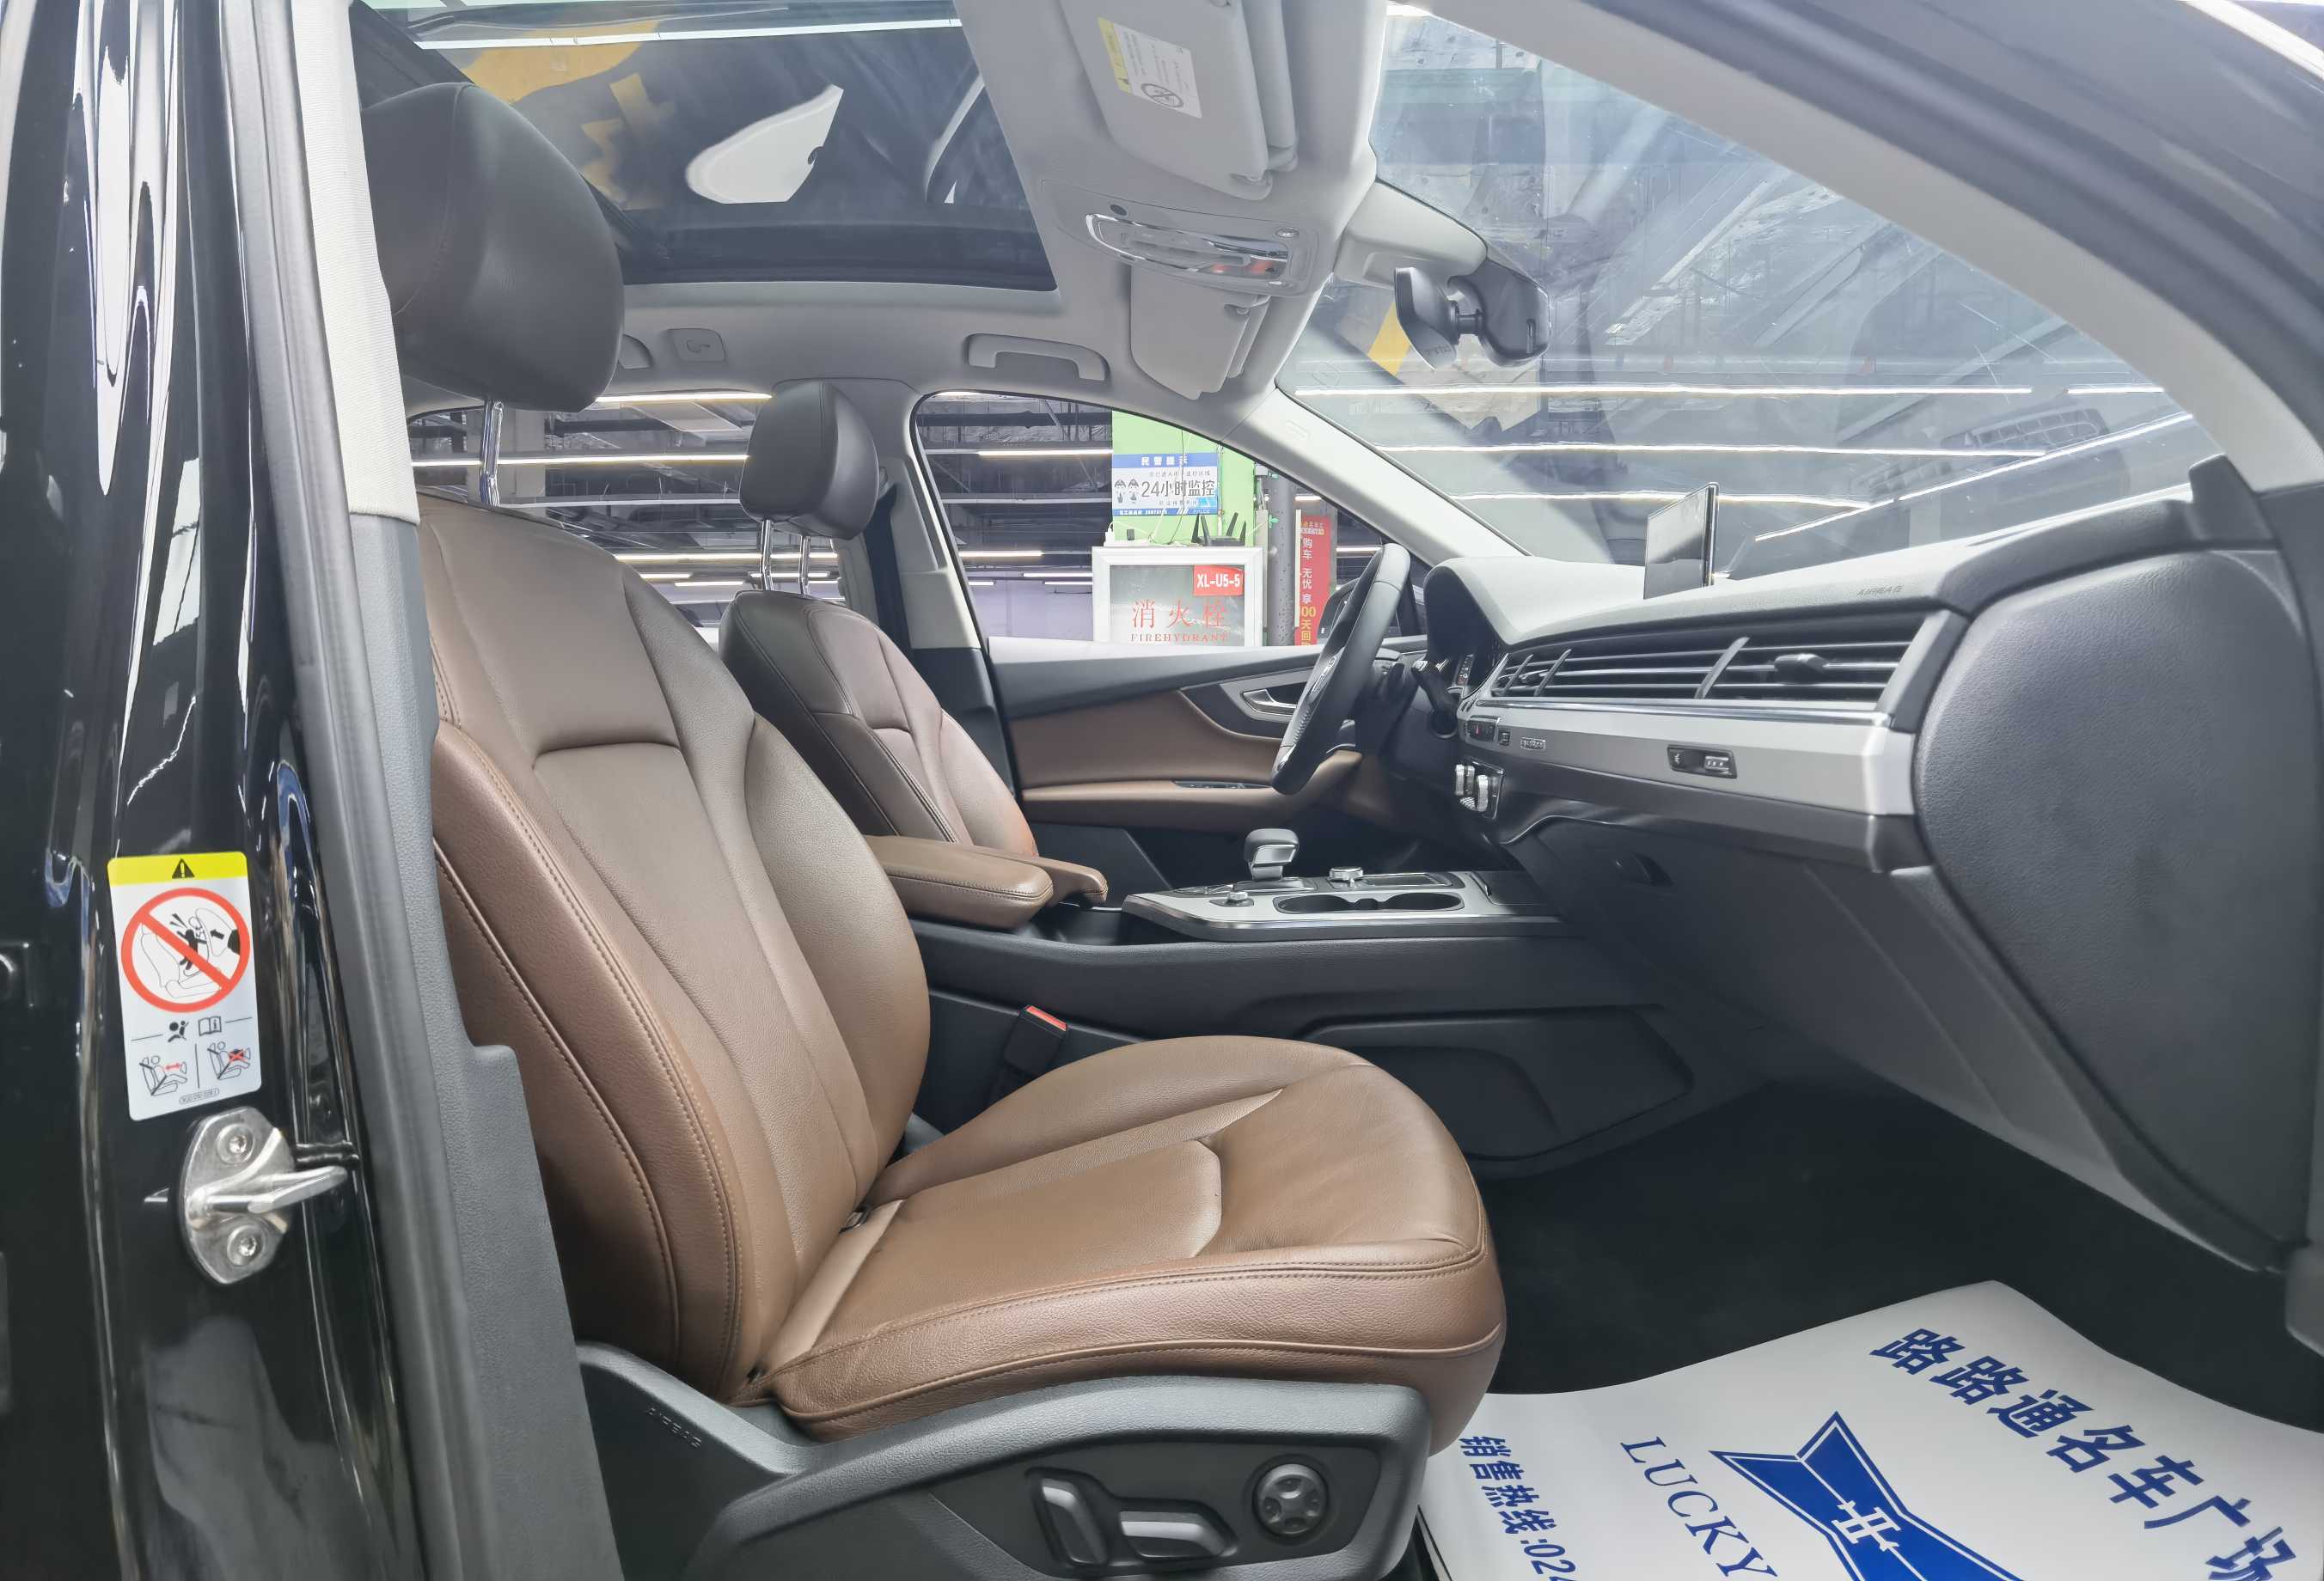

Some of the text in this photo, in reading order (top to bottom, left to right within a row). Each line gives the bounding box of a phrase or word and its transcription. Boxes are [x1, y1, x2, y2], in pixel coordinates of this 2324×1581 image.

[1141, 479, 1215, 497] 24小时监控
[1196, 573, 1240, 588] XL-U5-5
[1459, 1436, 1576, 1581] 销售热线:02
[1620, 1436, 1777, 1577] LUCKY
[1869, 1328, 2296, 1581] 路路通名车广场
